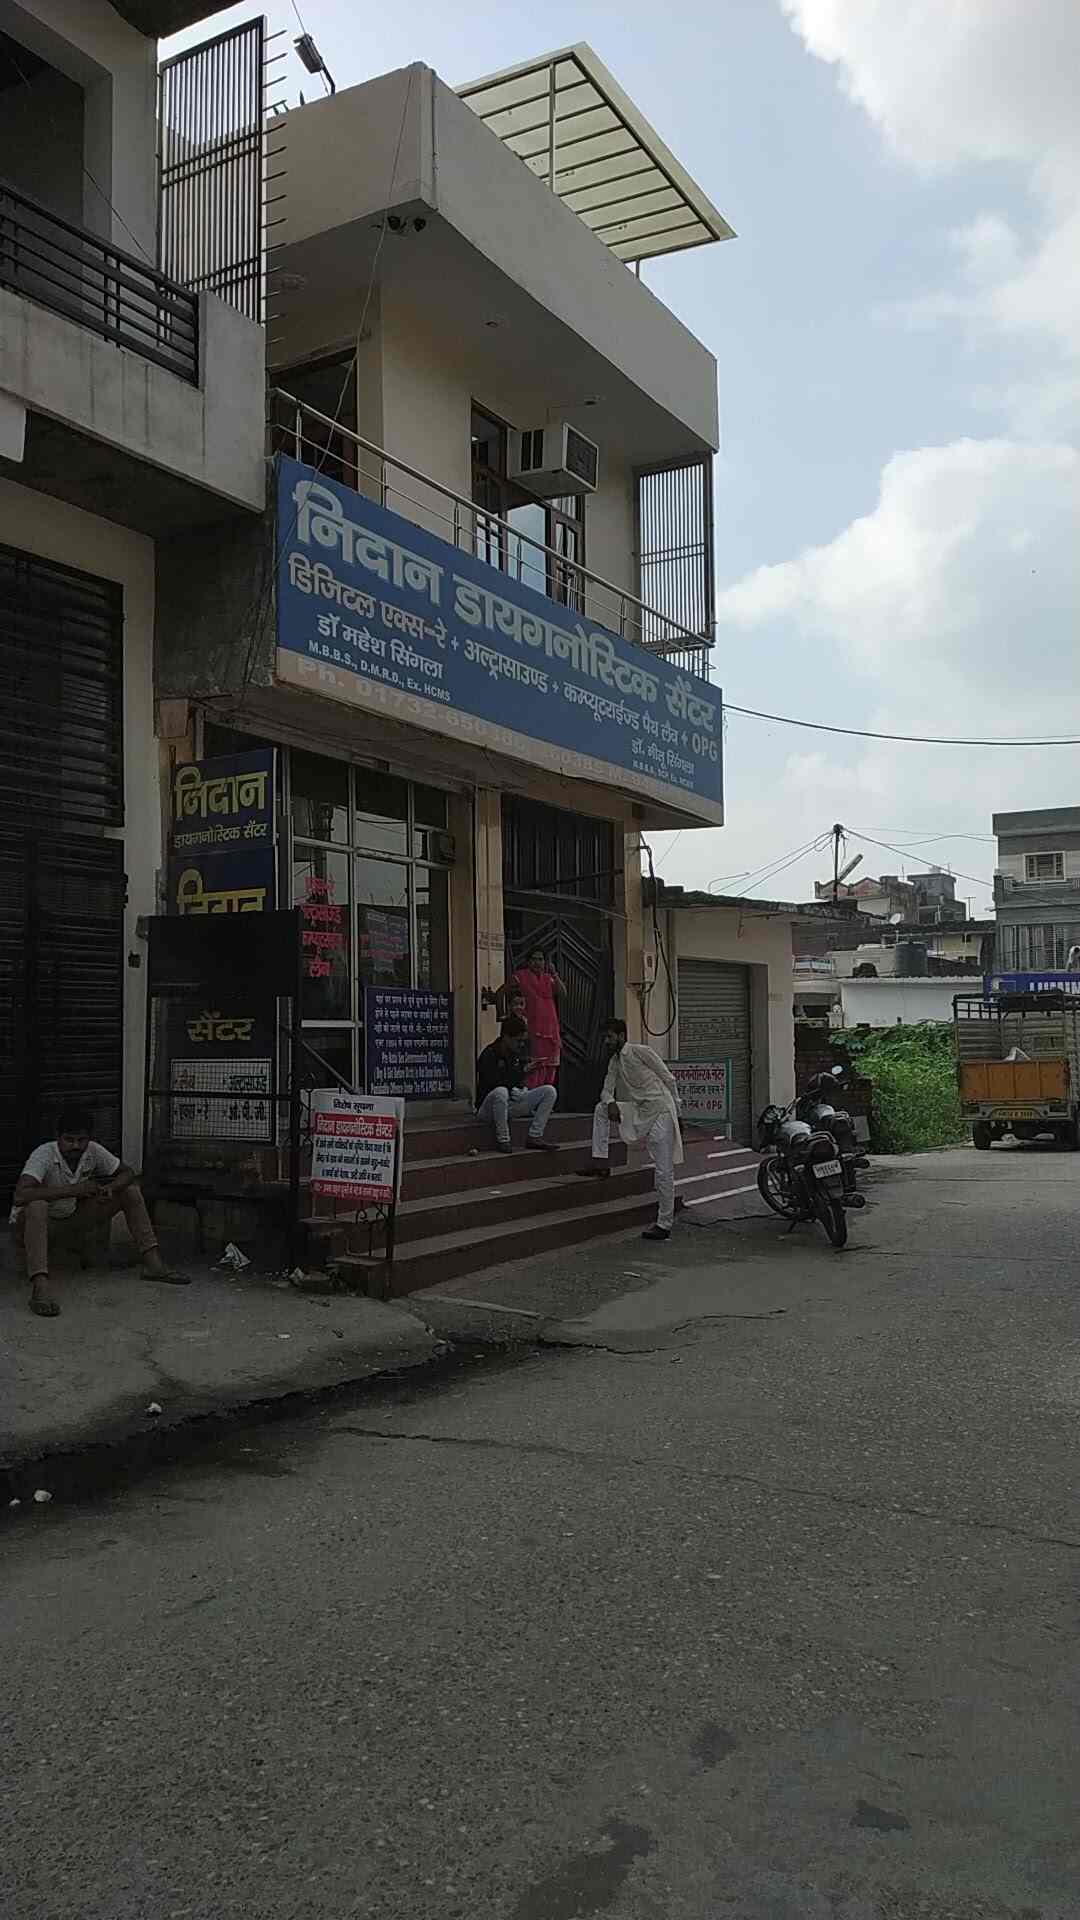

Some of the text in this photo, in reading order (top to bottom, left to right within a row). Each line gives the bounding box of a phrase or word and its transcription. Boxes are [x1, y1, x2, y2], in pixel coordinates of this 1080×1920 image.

[292, 480, 444, 606] निदान
[453, 574, 661, 703] डायगनोस्टिक
[288, 552, 376, 618] डिजिटल
[380, 600, 448, 648] एक्स-रे
[464, 638, 550, 692] अल्ट्रासाउण्ड
[692, 733, 719, 762] OPG
[342, 623, 386, 656] महेश
[390, 638, 443, 679] सिंगला
[407, 675, 422, 692] Ex.
[424, 684, 450, 702] HCMS
[175, 766, 269, 819] निदान
[174, 824, 241, 849] डायगनोस्टिक
